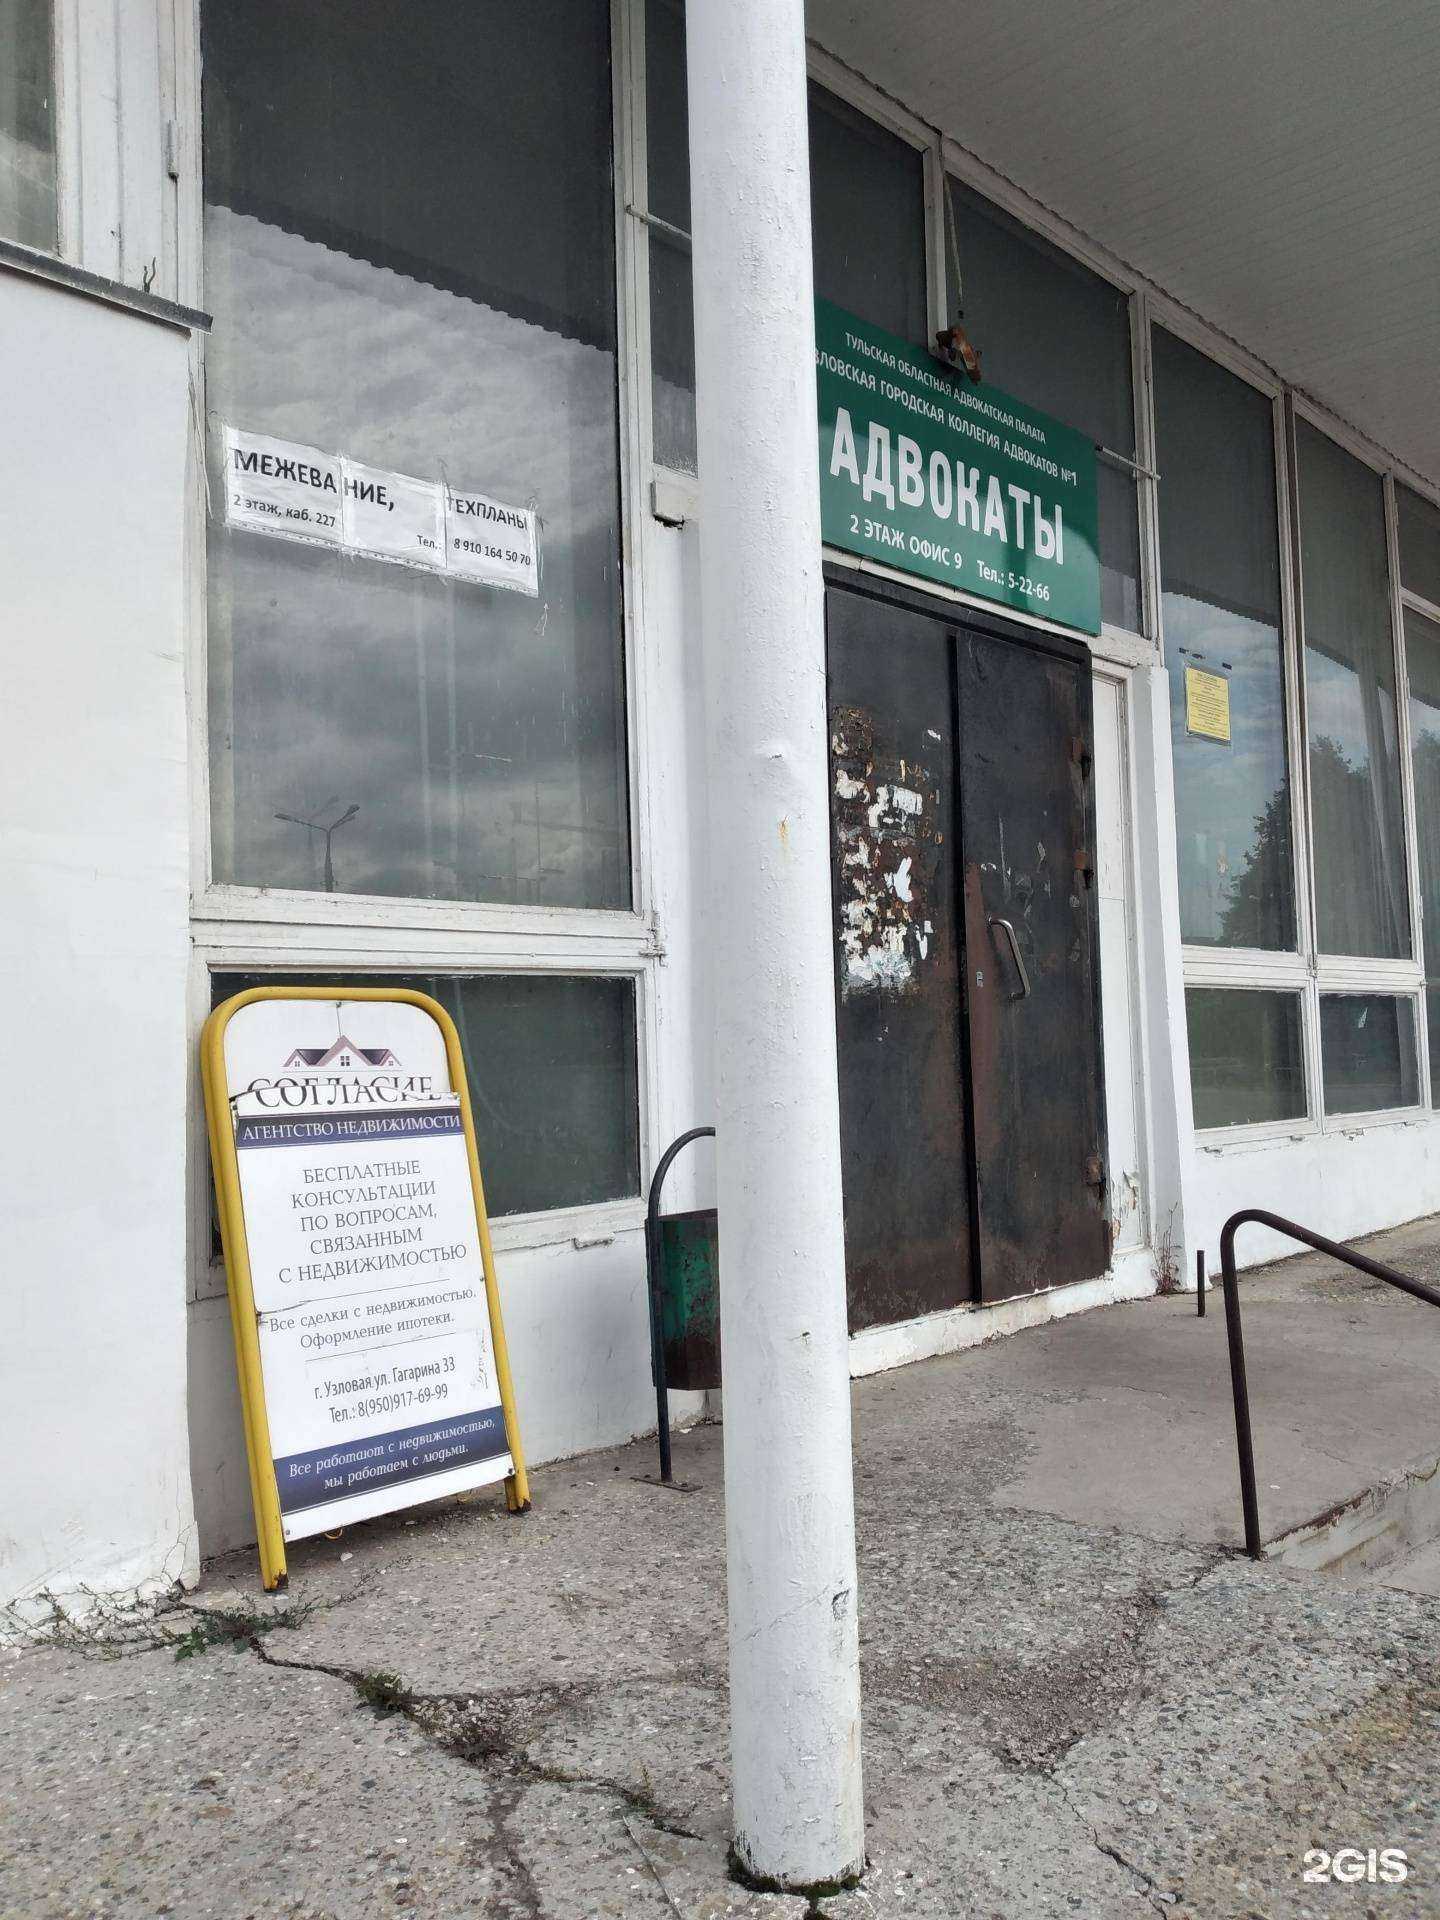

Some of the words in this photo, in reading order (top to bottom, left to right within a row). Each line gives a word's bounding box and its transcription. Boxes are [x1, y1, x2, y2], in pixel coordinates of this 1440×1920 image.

[845, 331, 897, 369] ТУЛЬСКАЯ
[898, 358, 951, 397] ОБЛАСТНАЯ
[954, 388, 1014, 428] АДВОКАТСКАЯ
[1015, 419, 1046, 444] ПАЛАТА
[814, 347, 876, 391] ЗЛОВСКАЯ
[880, 379, 944, 424] ГОРОДСКАЯ
[948, 413, 1000, 450] КОЛЛЕГИЯ
[1003, 442, 1058, 481] АДВОКАТОВ
[1061, 468, 1077, 486] №1
[829, 406, 1064, 565] АДВОКАТЫ
[233, 494, 241, 506] 2
[245, 499, 281, 517] этаж,
[286, 507, 312, 522] каб.
[316, 512, 336, 528] 227
[453, 538, 461, 549] 8
[463, 540, 481, 554] 910
[484, 545, 503, 559] 164
[505, 550, 518, 563] 50
[520, 553, 531, 566] 70
[446, 496, 528, 531] ТЕХПЛАНЫ
[850, 514, 859, 534] 2
[864, 518, 905, 550] ЭТАЖ
[909, 534, 951, 566] ОФИС
[954, 550, 963, 569] 9
[977, 559, 1004, 585] Тел.:
[1008, 572, 1050, 602] 5-22-66
[247, 1076, 442, 1108] СОГЛАСИЕ
[242, 1121, 333, 1141] АГЕНТСТВО
[336, 1115, 460, 1136] НЕДВИЖИМОСТИ
[303, 1160, 421, 1184] БЕСПЛАТНЫЕ
[291, 1181, 436, 1209] КОНСУЛЬТАЦИИ
[300, 1215, 328, 1232] ПО
[336, 1203, 437, 1229] ВОПРОСАМ,
[310, 1227, 423, 1255] СВЯЗАННЫМ
[278, 1268, 292, 1284] С
[298, 1244, 467, 1283] НЕДВИЖИМОСТЬЮ
[269, 1317, 295, 1333] Все
[300, 1311, 349, 1329] сделки
[353, 1307, 361, 1318] с
[366, 1286, 477, 1316] недвижимостью.
[300, 1322, 392, 1350] Оформление
[397, 1311, 455, 1332] ипотеки.
[314, 1387, 323, 1400] г.
[324, 1376, 372, 1397] Узловая
[375, 1372, 391, 1391] ул.
[392, 1362, 441, 1383] Гагарина
[442, 1356, 456, 1373] 33
[329, 1405, 355, 1423] Тел.:
[357, 1383, 448, 1417] 8(950)917-69-99
[289, 1463, 311, 1478] Все
[316, 1444, 384, 1471] работают
[388, 1442, 395, 1453] с
[399, 1419, 496, 1451] недвижимостью,
[323, 1475, 344, 1490] мы
[348, 1458, 409, 1484] работаем
[412, 1456, 419, 1467] с
[422, 1443, 469, 1464] людьми.
